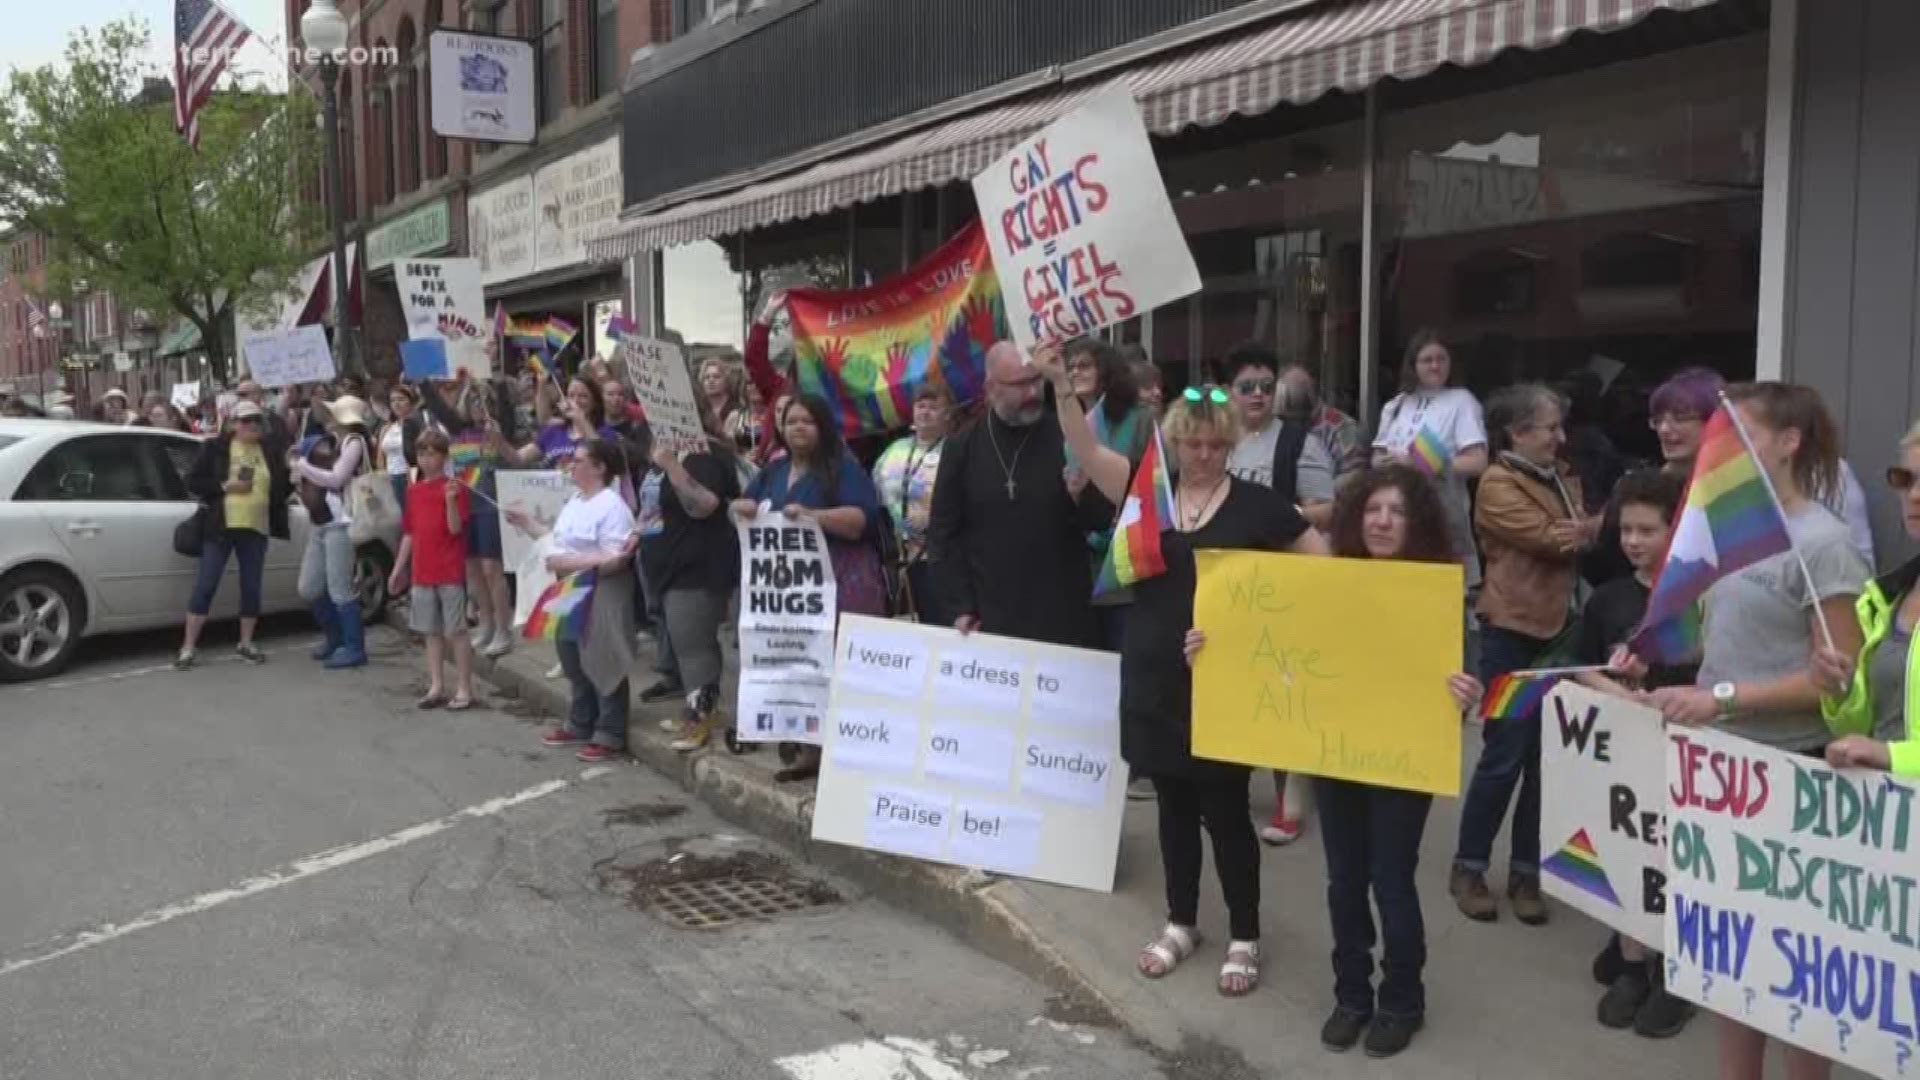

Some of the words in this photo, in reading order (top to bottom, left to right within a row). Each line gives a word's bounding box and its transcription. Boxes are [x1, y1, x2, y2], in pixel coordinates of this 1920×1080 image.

[1010, 138, 1051, 195] GAY
[1001, 153, 1109, 256] RIGHTS
[407, 264, 441, 277] BEST
[422, 280, 446, 293] FIX
[827, 301, 881, 329] LOVE
[916, 258, 973, 293] LOVE
[1023, 242, 1121, 312] CIVIL
[411, 294, 435, 307] FOR
[444, 295, 455, 307] A
[749, 528, 818, 551] FREE
[750, 555, 824, 589] MOM
[1224, 562, 1295, 613] We
[750, 591, 824, 615] HUGS
[848, 641, 853, 660] I
[860, 648, 914, 671] wear
[940, 660, 953, 675] a
[960, 659, 1020, 688] dress
[1036, 671, 1060, 693] to
[1252, 624, 1343, 679] Are
[1253, 682, 1311, 733] All
[1554, 696, 1611, 763] WE
[839, 719, 890, 744] work
[931, 735, 960, 755] on
[1027, 744, 1108, 783] Sunday
[875, 797, 942, 827] Praise
[962, 810, 1001, 837] be!
[1609, 784, 1667, 847] RE
[1670, 734, 1770, 819] JESUS
[1788, 758, 1916, 853] DIDN'T
[1733, 831, 1920, 950] DISCRIMI
[1675, 893, 1755, 982] WHY
